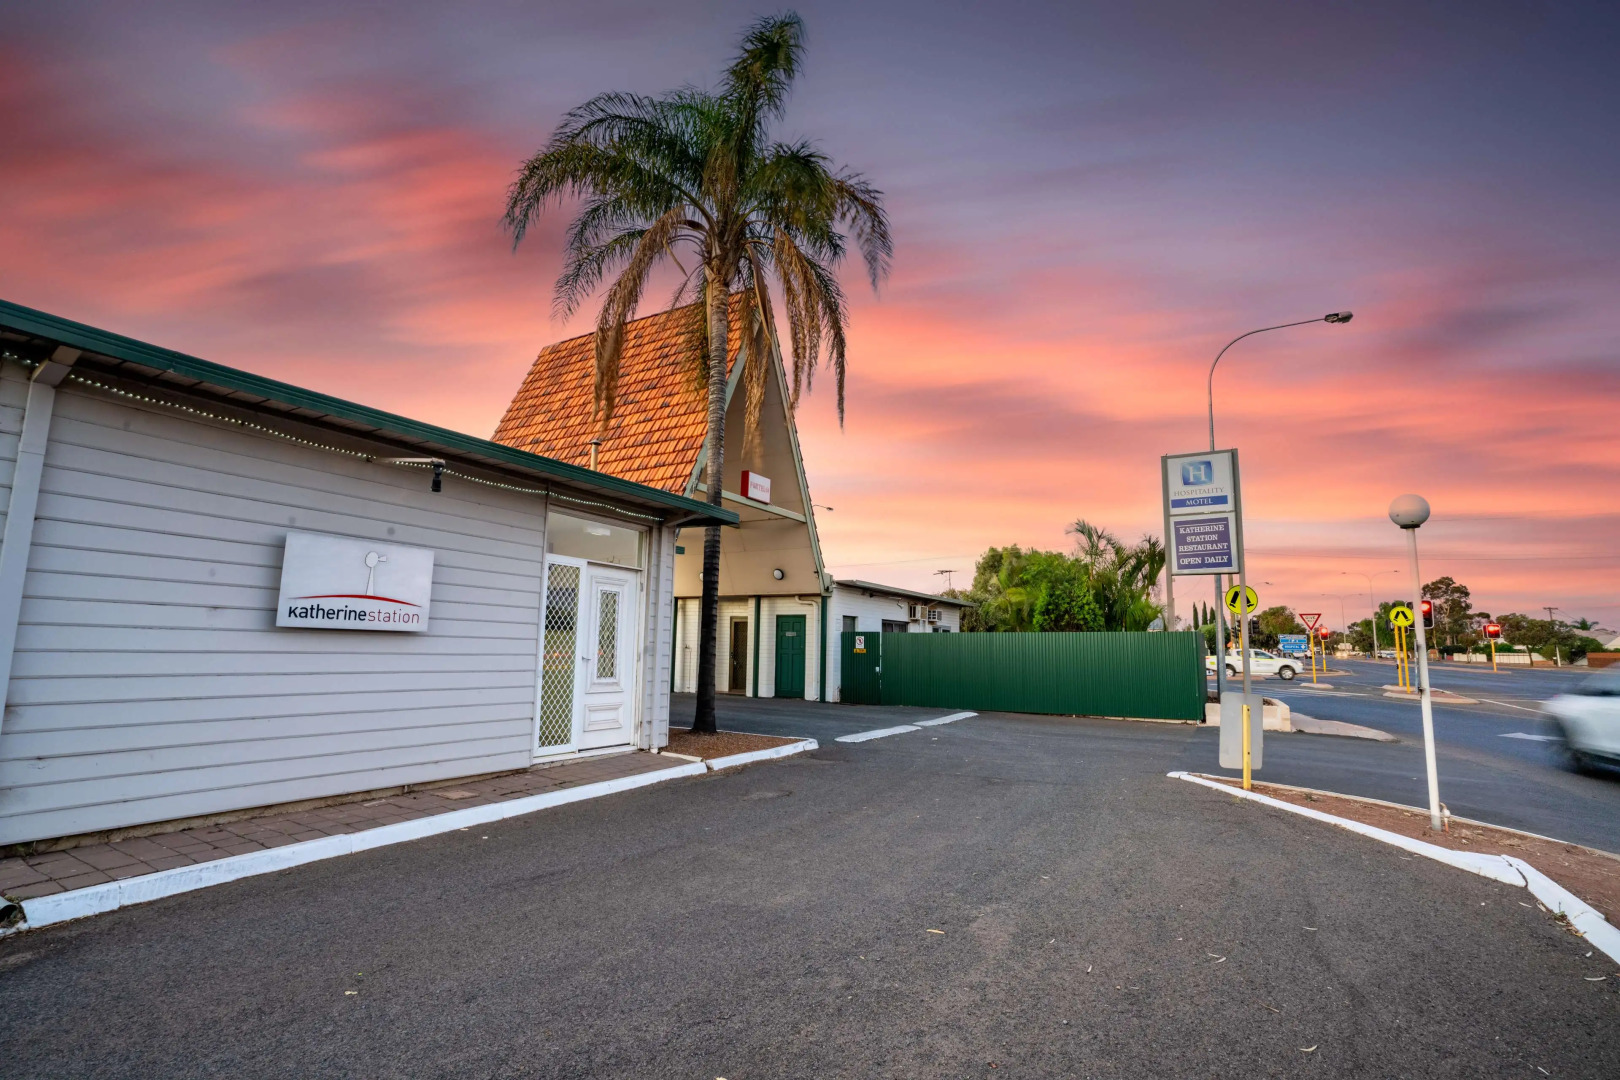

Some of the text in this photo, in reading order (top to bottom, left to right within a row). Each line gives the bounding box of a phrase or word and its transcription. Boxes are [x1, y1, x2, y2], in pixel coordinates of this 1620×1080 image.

[1188, 464, 1207, 483] H
[1174, 486, 1225, 497] HOSPITALITY
[1185, 498, 1214, 506] MOTEL
[1179, 524, 1225, 534] KATHERINE
[1186, 534, 1218, 543] STATION
[1178, 543, 1229, 552] RESTAURANT
[1180, 556, 1229, 565] OPEN DAILY
